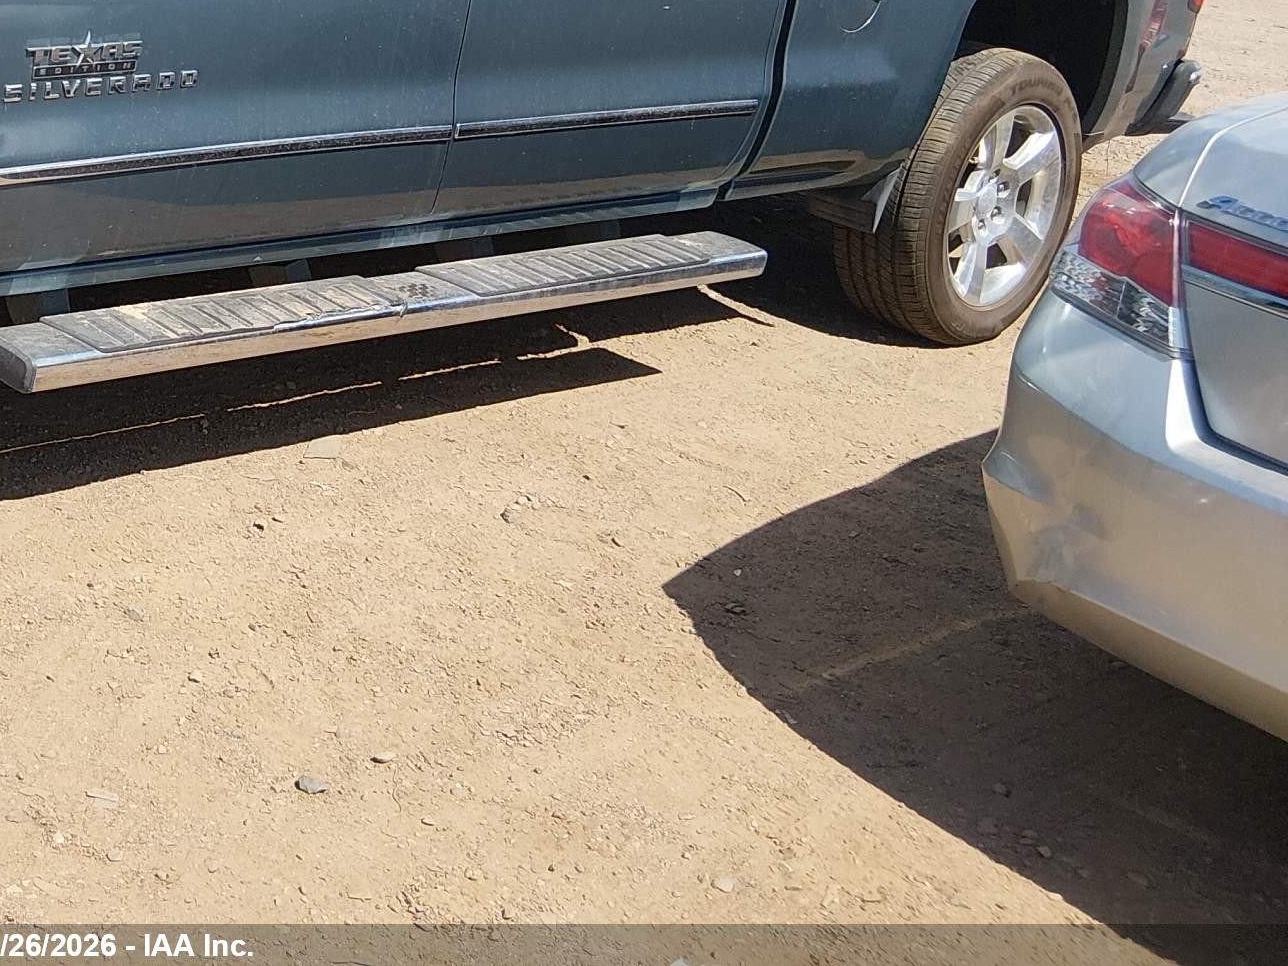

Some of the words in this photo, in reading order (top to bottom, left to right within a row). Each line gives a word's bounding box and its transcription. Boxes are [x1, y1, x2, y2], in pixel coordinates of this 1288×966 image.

[25, 39, 143, 65] TEXAS
[39, 61, 132, 76] EDITION
[3, 70, 199, 103] SILVERADO
